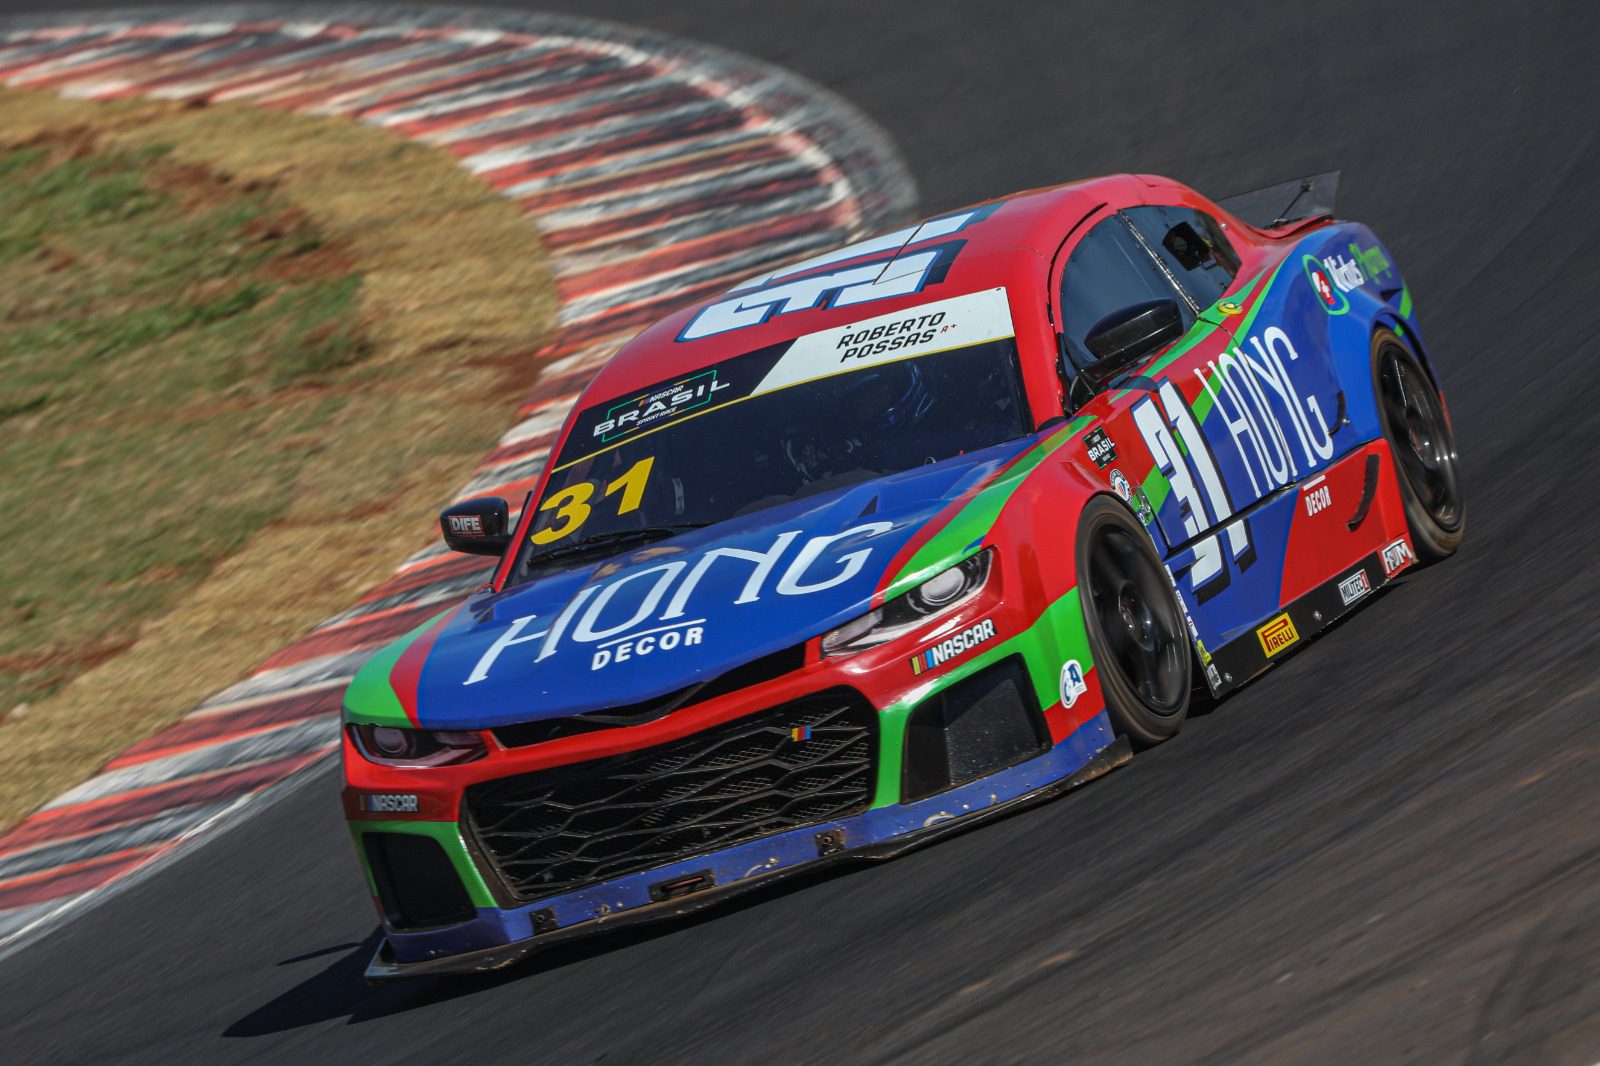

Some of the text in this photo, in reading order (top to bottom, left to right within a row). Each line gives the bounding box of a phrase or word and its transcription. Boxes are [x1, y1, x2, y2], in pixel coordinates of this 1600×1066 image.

[836, 311, 947, 350] ROBERTO
[840, 328, 937, 363] POSSAS
[593, 379, 731, 437] BRASIL
[1194, 326, 1333, 499] HONG
[1087, 437, 1115, 461] BRASIL
[530, 455, 655, 546] 31
[1131, 377, 1250, 591] 31
[1304, 485, 1332, 517] DECOR
[451, 516, 482, 532] DIFE
[462, 521, 896, 686] HONG
[590, 625, 704, 672] DECOR
[931, 618, 996, 667] NASCAR
[1261, 617, 1295, 653] PIRELLI
[369, 794, 418, 812] NASCAR
